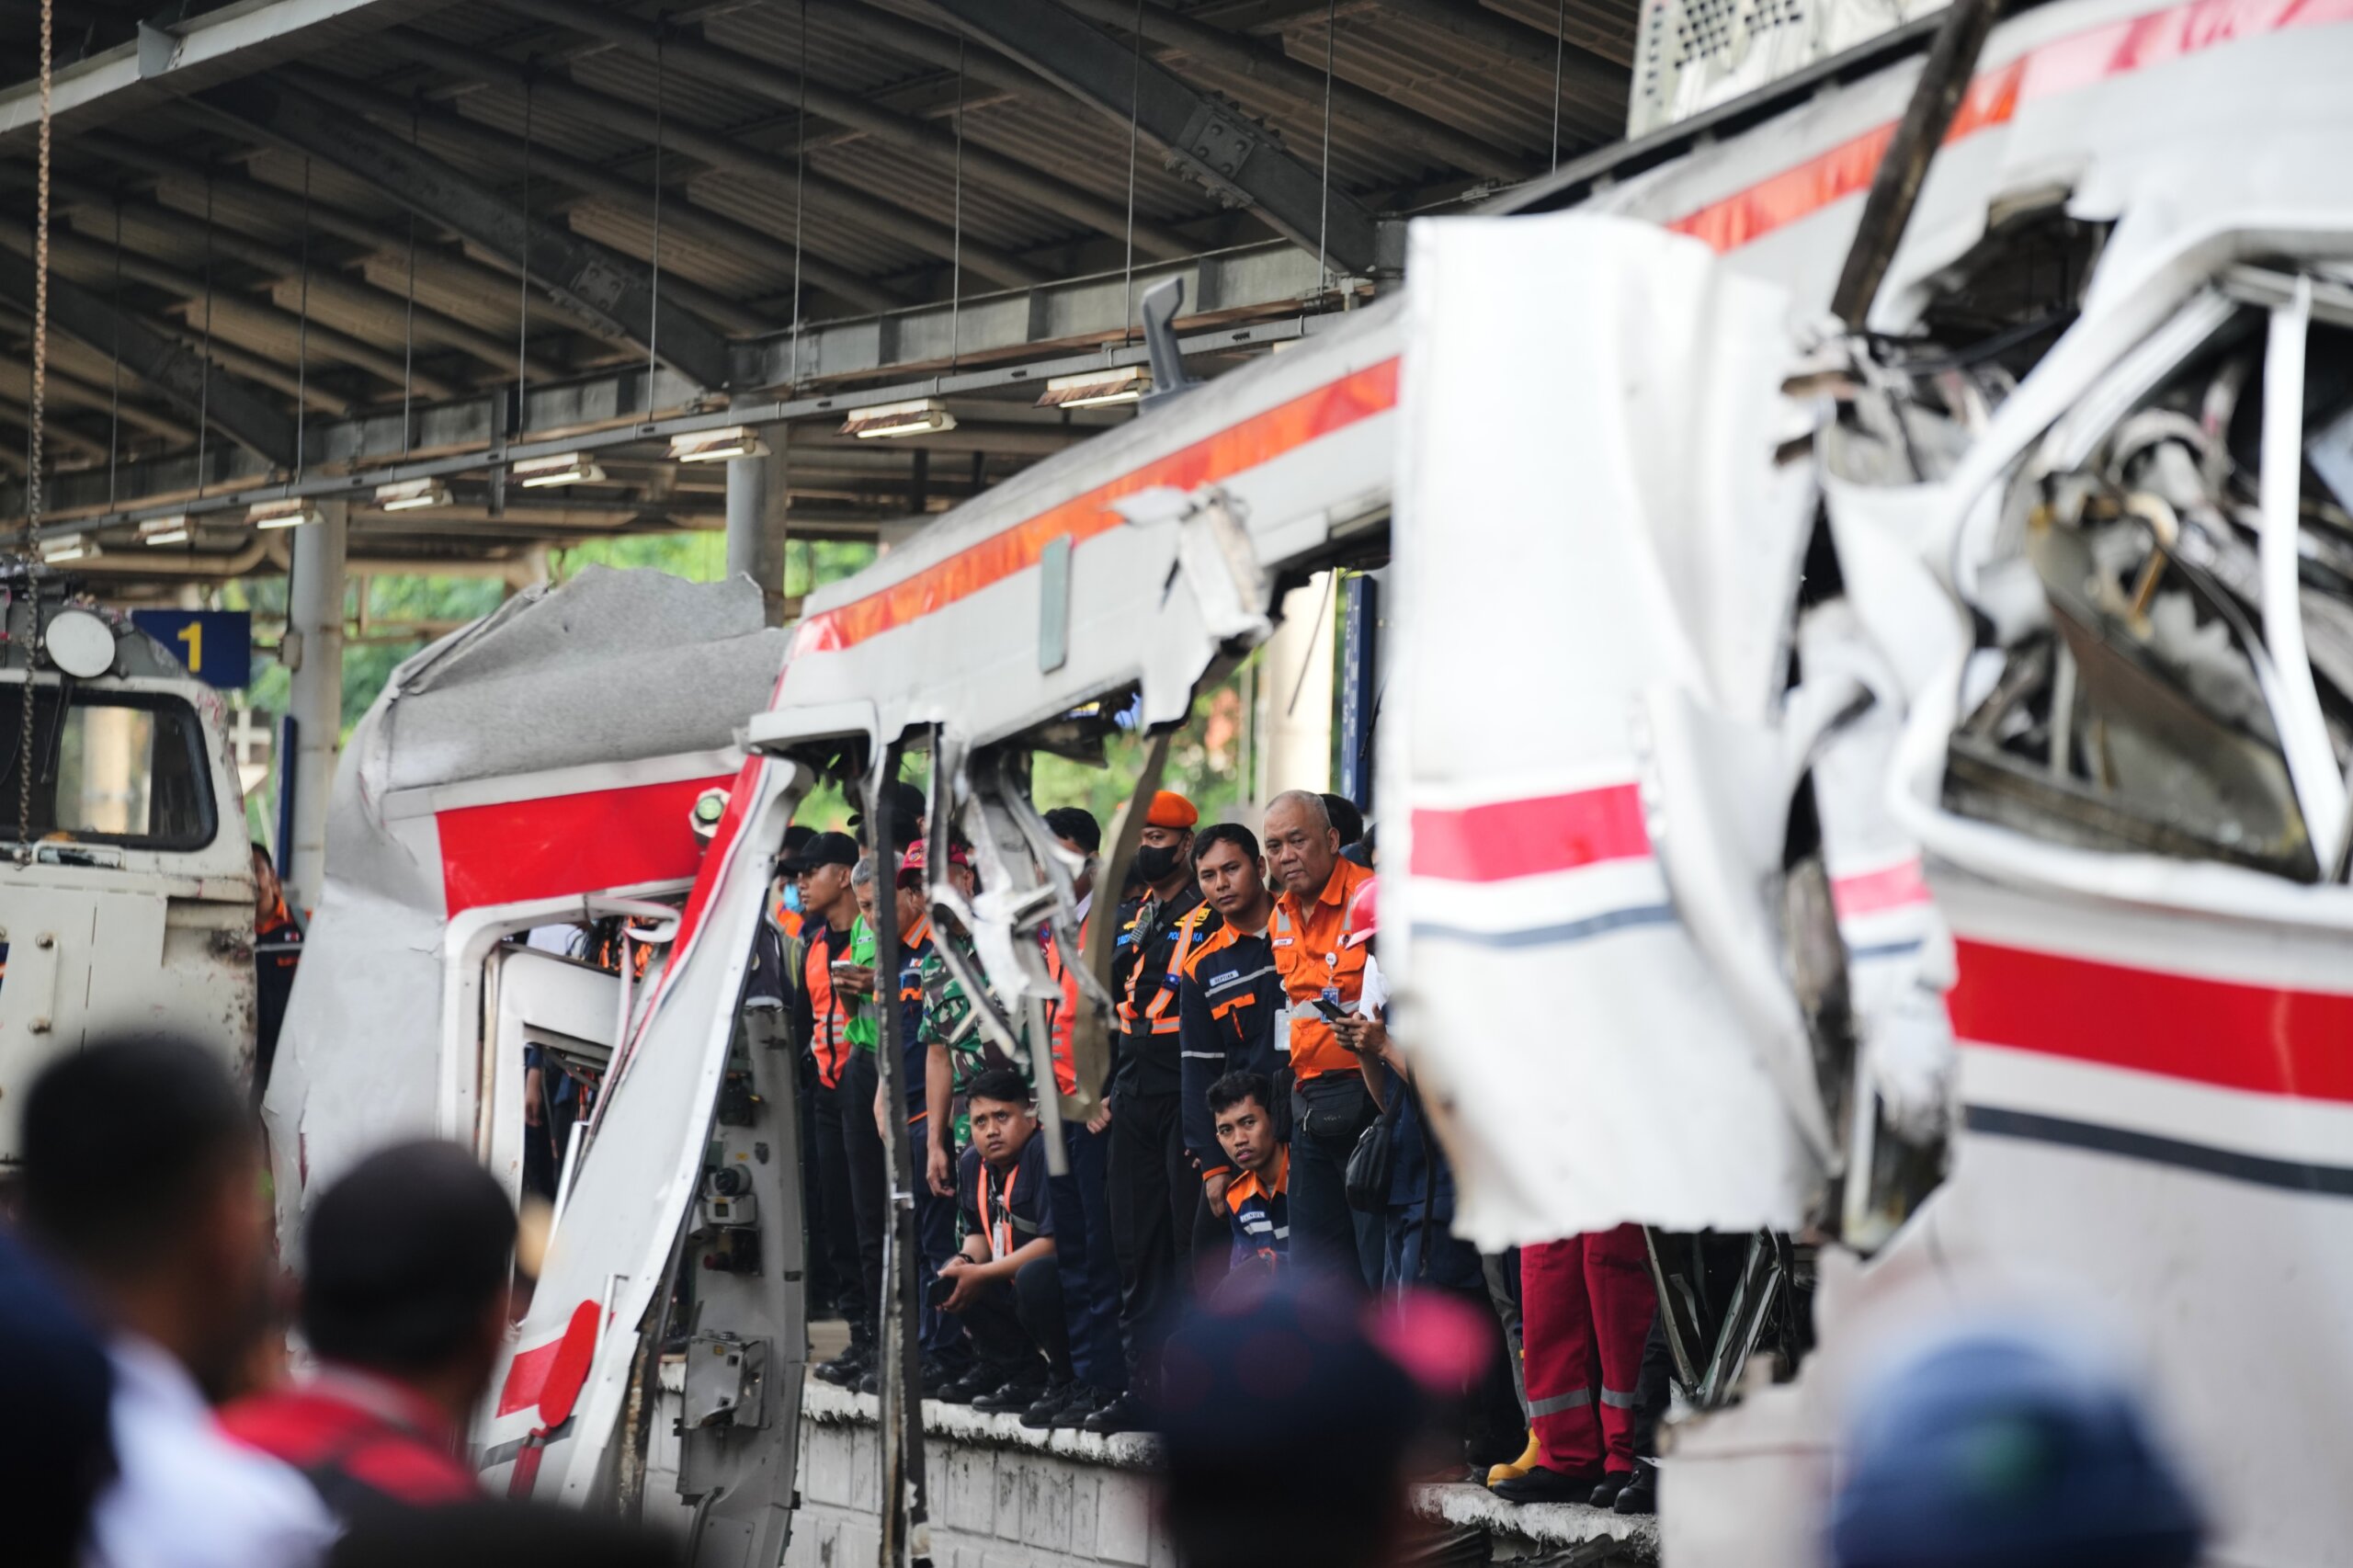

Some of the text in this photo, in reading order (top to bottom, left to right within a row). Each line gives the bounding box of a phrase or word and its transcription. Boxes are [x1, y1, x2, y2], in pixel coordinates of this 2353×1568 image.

[177, 621, 201, 673] 1
[1342, 592, 1352, 751] BEKASI
[1349, 605, 1359, 737] TIMUR
[1167, 931, 1203, 942] POLKA
